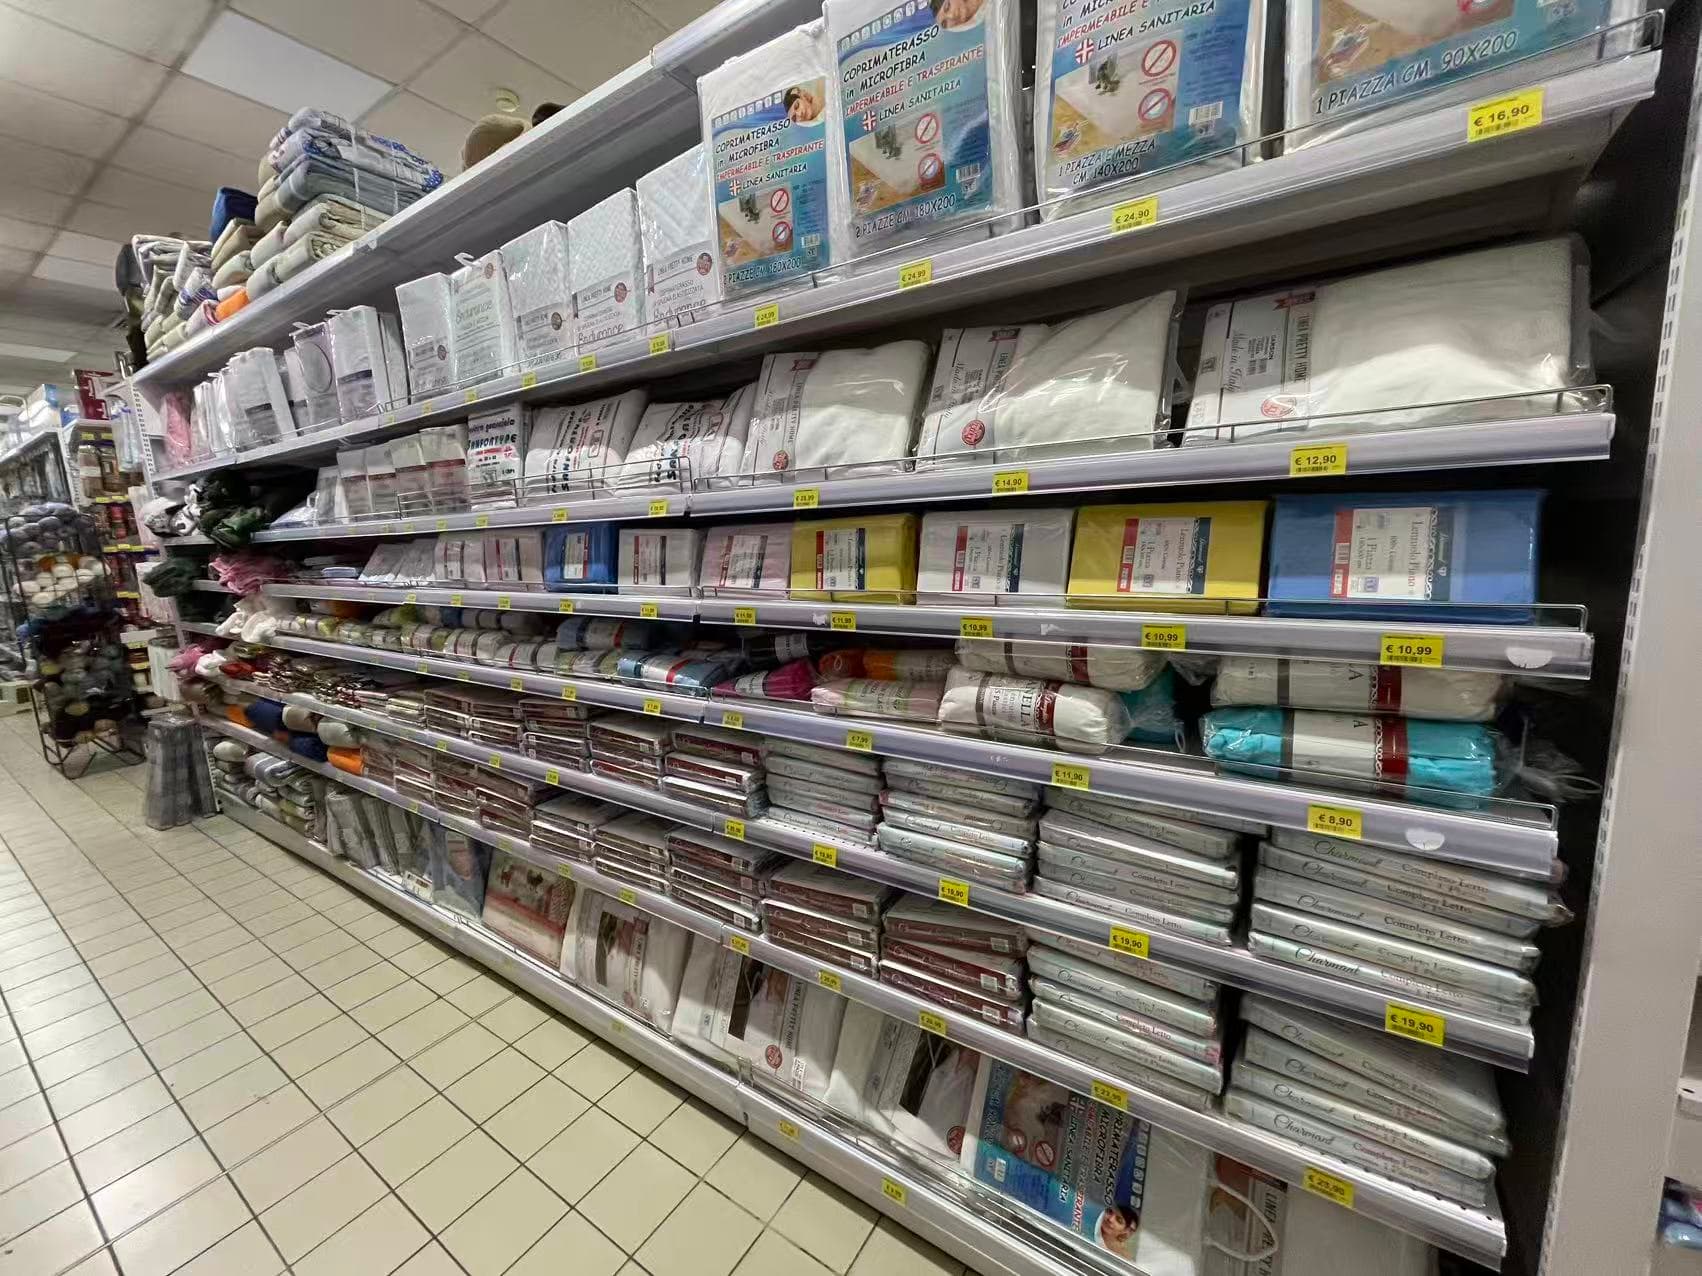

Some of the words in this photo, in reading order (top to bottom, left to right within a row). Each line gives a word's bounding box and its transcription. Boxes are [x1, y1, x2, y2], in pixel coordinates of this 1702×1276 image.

[1057, 2, 1137, 48] IMPERMEABILE
[1098, 27, 1134, 50] LINEA
[1138, 0, 1215, 33] SANITARIA
[844, 25, 939, 82] COPRIMATERASSO
[847, 80, 904, 115] IMPERMEABILE
[917, 45, 984, 81] TRASPIRANTE
[860, 51, 926, 92] MICROFIBRA
[1315, 97, 1323, 114] 1
[1327, 73, 1397, 110] PIAZZA
[1441, 31, 1519, 72] 90X200
[879, 102, 905, 121] LINEA
[908, 79, 961, 108] SANITARIA
[1473, 118, 1484, 127] €
[1488, 104, 1530, 124] 16,90
[715, 118, 791, 154] COPRIMATERASSO
[719, 158, 762, 180] IMPERMEABILE
[773, 140, 824, 161] TRASPIRANTE
[728, 138, 780, 162] MICROFIBRA
[1064, 153, 1100, 173] PIAZZA
[1115, 138, 1157, 159] MEZZA
[742, 178, 763, 190] LINEA
[766, 163, 807, 181] SANITARIA
[1092, 157, 1140, 178] 140X200
[861, 214, 894, 235] PIAZZE
[915, 194, 956, 217] 180X200
[1123, 209, 1150, 222] 24,90
[729, 270, 753, 283] PIAZZE
[1294, 333, 1308, 360] PRETTY
[1294, 361, 1307, 382] HOME
[1295, 457, 1302, 465] €
[1306, 454, 1337, 465] 12,90
[1002, 477, 1022, 487] 14,90
[1366, 543, 1378, 570] Piazza
[1407, 562, 1420, 587] Piano
[1152, 633, 1178, 642] 10,99
[1385, 645, 1394, 653] €
[1398, 645, 1433, 655] 10,99
[1063, 771, 1084, 781] 11,90
[1319, 814, 1326, 822] €
[1328, 815, 1353, 827] 8,90
[1442, 899, 1473, 913] Letto
[1120, 936, 1143, 949] 19,90
[1384, 914, 1435, 935] Completo
[1439, 929, 1468, 944] Letto
[1295, 947, 1360, 975] Charmant
[1390, 1014, 1398, 1022] €
[1401, 1016, 1434, 1033] 19,90
[1273, 1113, 1336, 1145] Charmant
[1093, 1108, 1111, 1184] MICROFIBRA
[1059, 1143, 1073, 1204] SANITARIA
